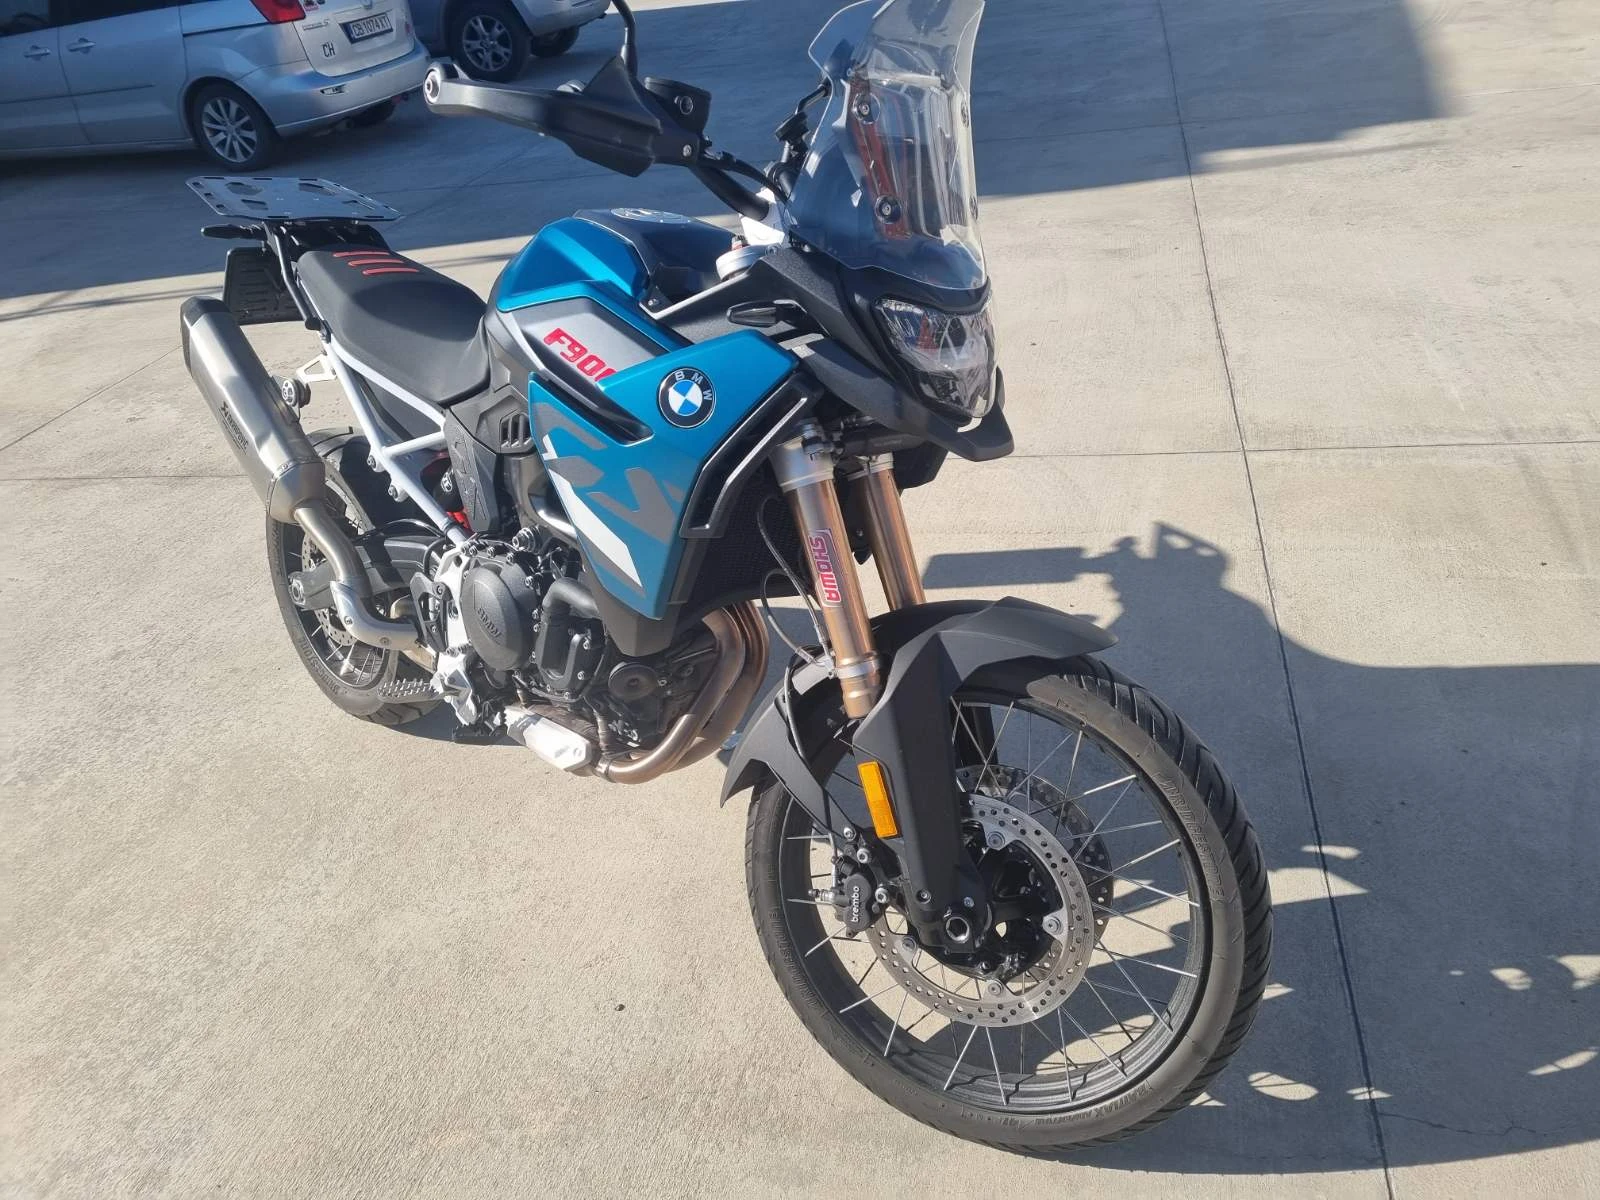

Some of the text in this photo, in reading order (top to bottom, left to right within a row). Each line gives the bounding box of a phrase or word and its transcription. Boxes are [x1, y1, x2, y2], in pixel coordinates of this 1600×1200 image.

[322, 42, 336, 57] CH
[675, 371, 712, 400] BMW
[808, 535, 842, 602] SHOWA
[478, 607, 502, 637] BMW
[852, 886, 860, 922] brembo
